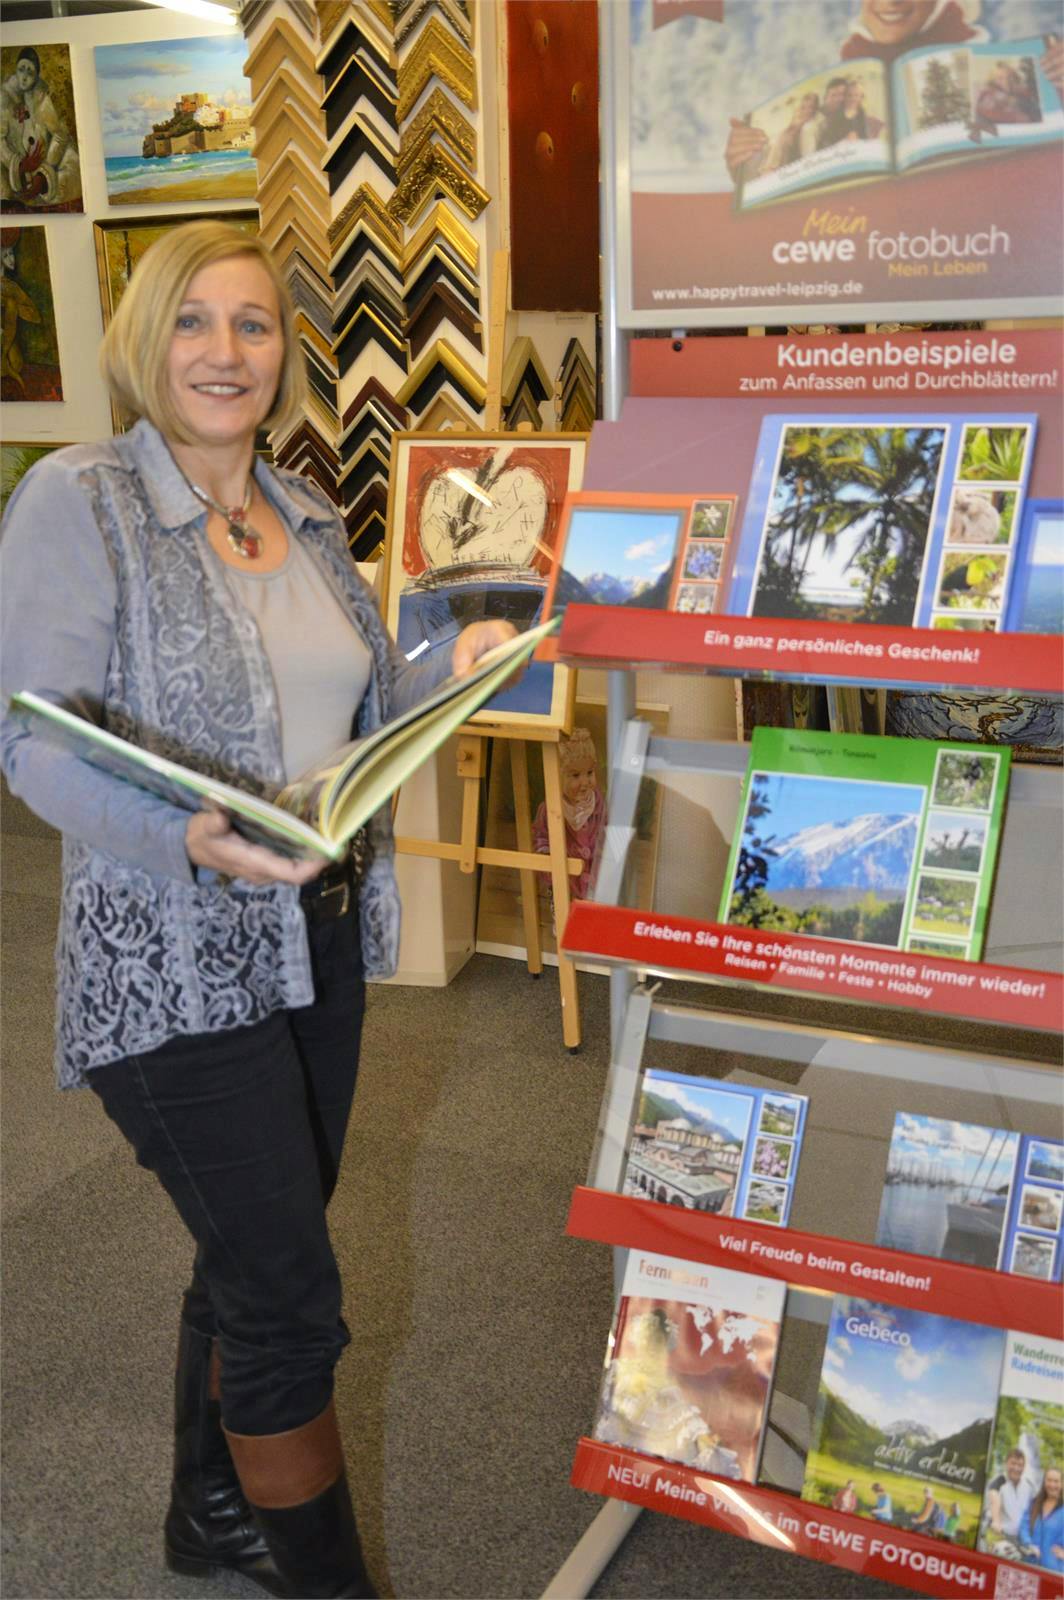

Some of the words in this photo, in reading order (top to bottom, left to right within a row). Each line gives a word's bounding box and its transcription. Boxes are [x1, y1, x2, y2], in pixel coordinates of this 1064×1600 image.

[803, 206, 867, 236] Mein
[772, 238, 856, 264] cewe
[867, 225, 1010, 260] fotobuch
[888, 263, 928, 277] Mein
[933, 260, 988, 276] Leben
[652, 281, 863, 300] www.happytravel-leipzig.de
[778, 339, 1017, 369] Kundenbeispiele
[739, 376, 777, 391] zum
[783, 373, 867, 390] Anfassen
[872, 372, 909, 389] und
[915, 369, 1058, 388] Durchblättern!
[704, 630, 730, 645] Ein
[733, 635, 773, 649] ganz
[777, 637, 883, 658] persönliches
[888, 643, 980, 665] Geschenk!
[634, 921, 692, 943] Erleben
[694, 931, 719, 948] Sie
[722, 935, 753, 953] Ihre
[755, 942, 836, 966] schönsten
[840, 953, 917, 979] Momente
[920, 965, 976, 987] immer
[980, 976, 1045, 999] wieder!
[725, 953, 767, 970] Reisen
[779, 962, 825, 980] Familie
[838, 971, 874, 987] Feste
[887, 979, 933, 998] Hobby
[719, 1234, 747, 1252] Viel
[750, 1241, 804, 1264] Freude
[807, 1252, 846, 1273] beim
[850, 1262, 931, 1291] Gestalten!
[845, 1317, 911, 1346] Gebeco
[919, 1447, 976, 1482] erleben
[607, 1463, 650, 1489] NEU!
[655, 1477, 707, 1506] Meine
[777, 1511, 799, 1534] im
[804, 1520, 866, 1552] CEWE
[869, 1539, 986, 1590] FOTOBUCH
